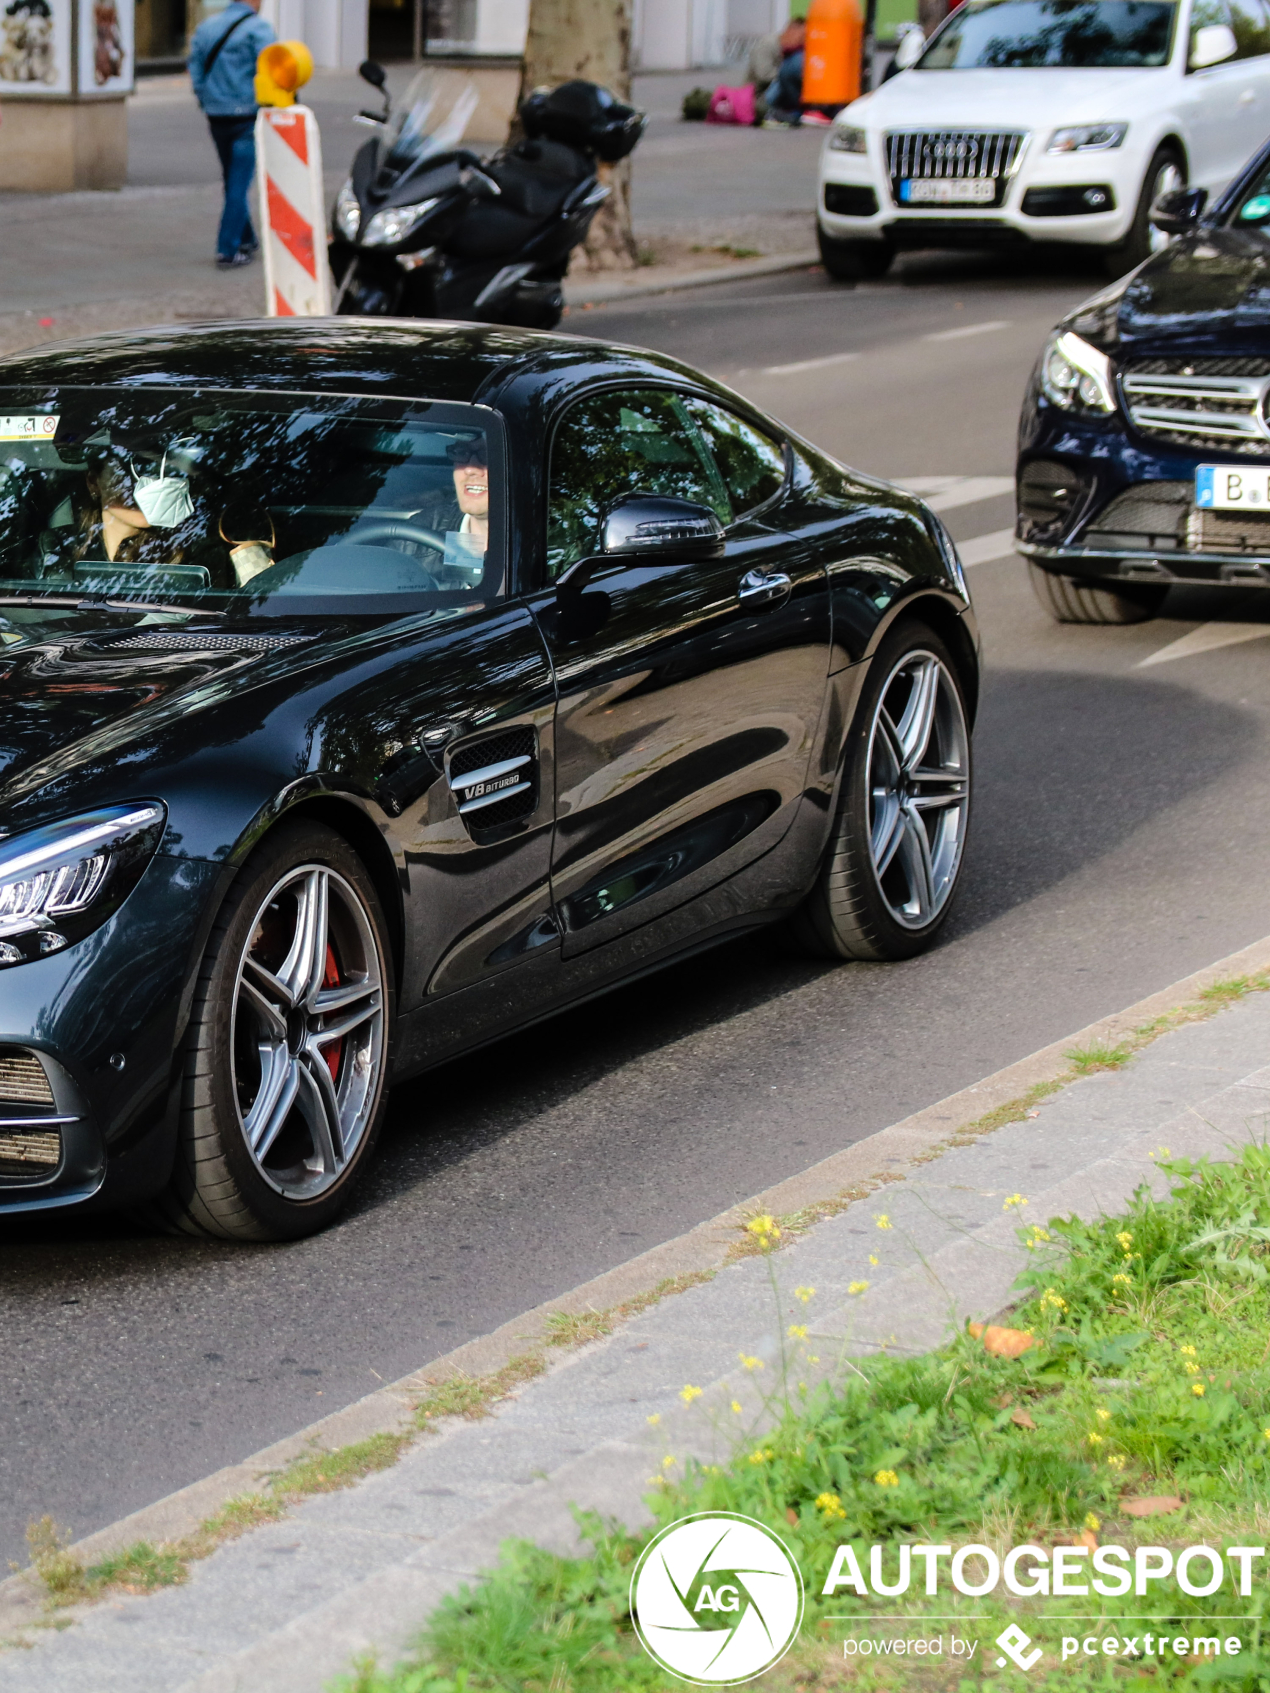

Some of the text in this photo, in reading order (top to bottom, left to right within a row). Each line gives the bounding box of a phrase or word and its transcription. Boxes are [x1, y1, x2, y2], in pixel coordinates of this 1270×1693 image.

[1227, 474, 1242, 501] B
[464, 774, 520, 800] V8 BITURBO
